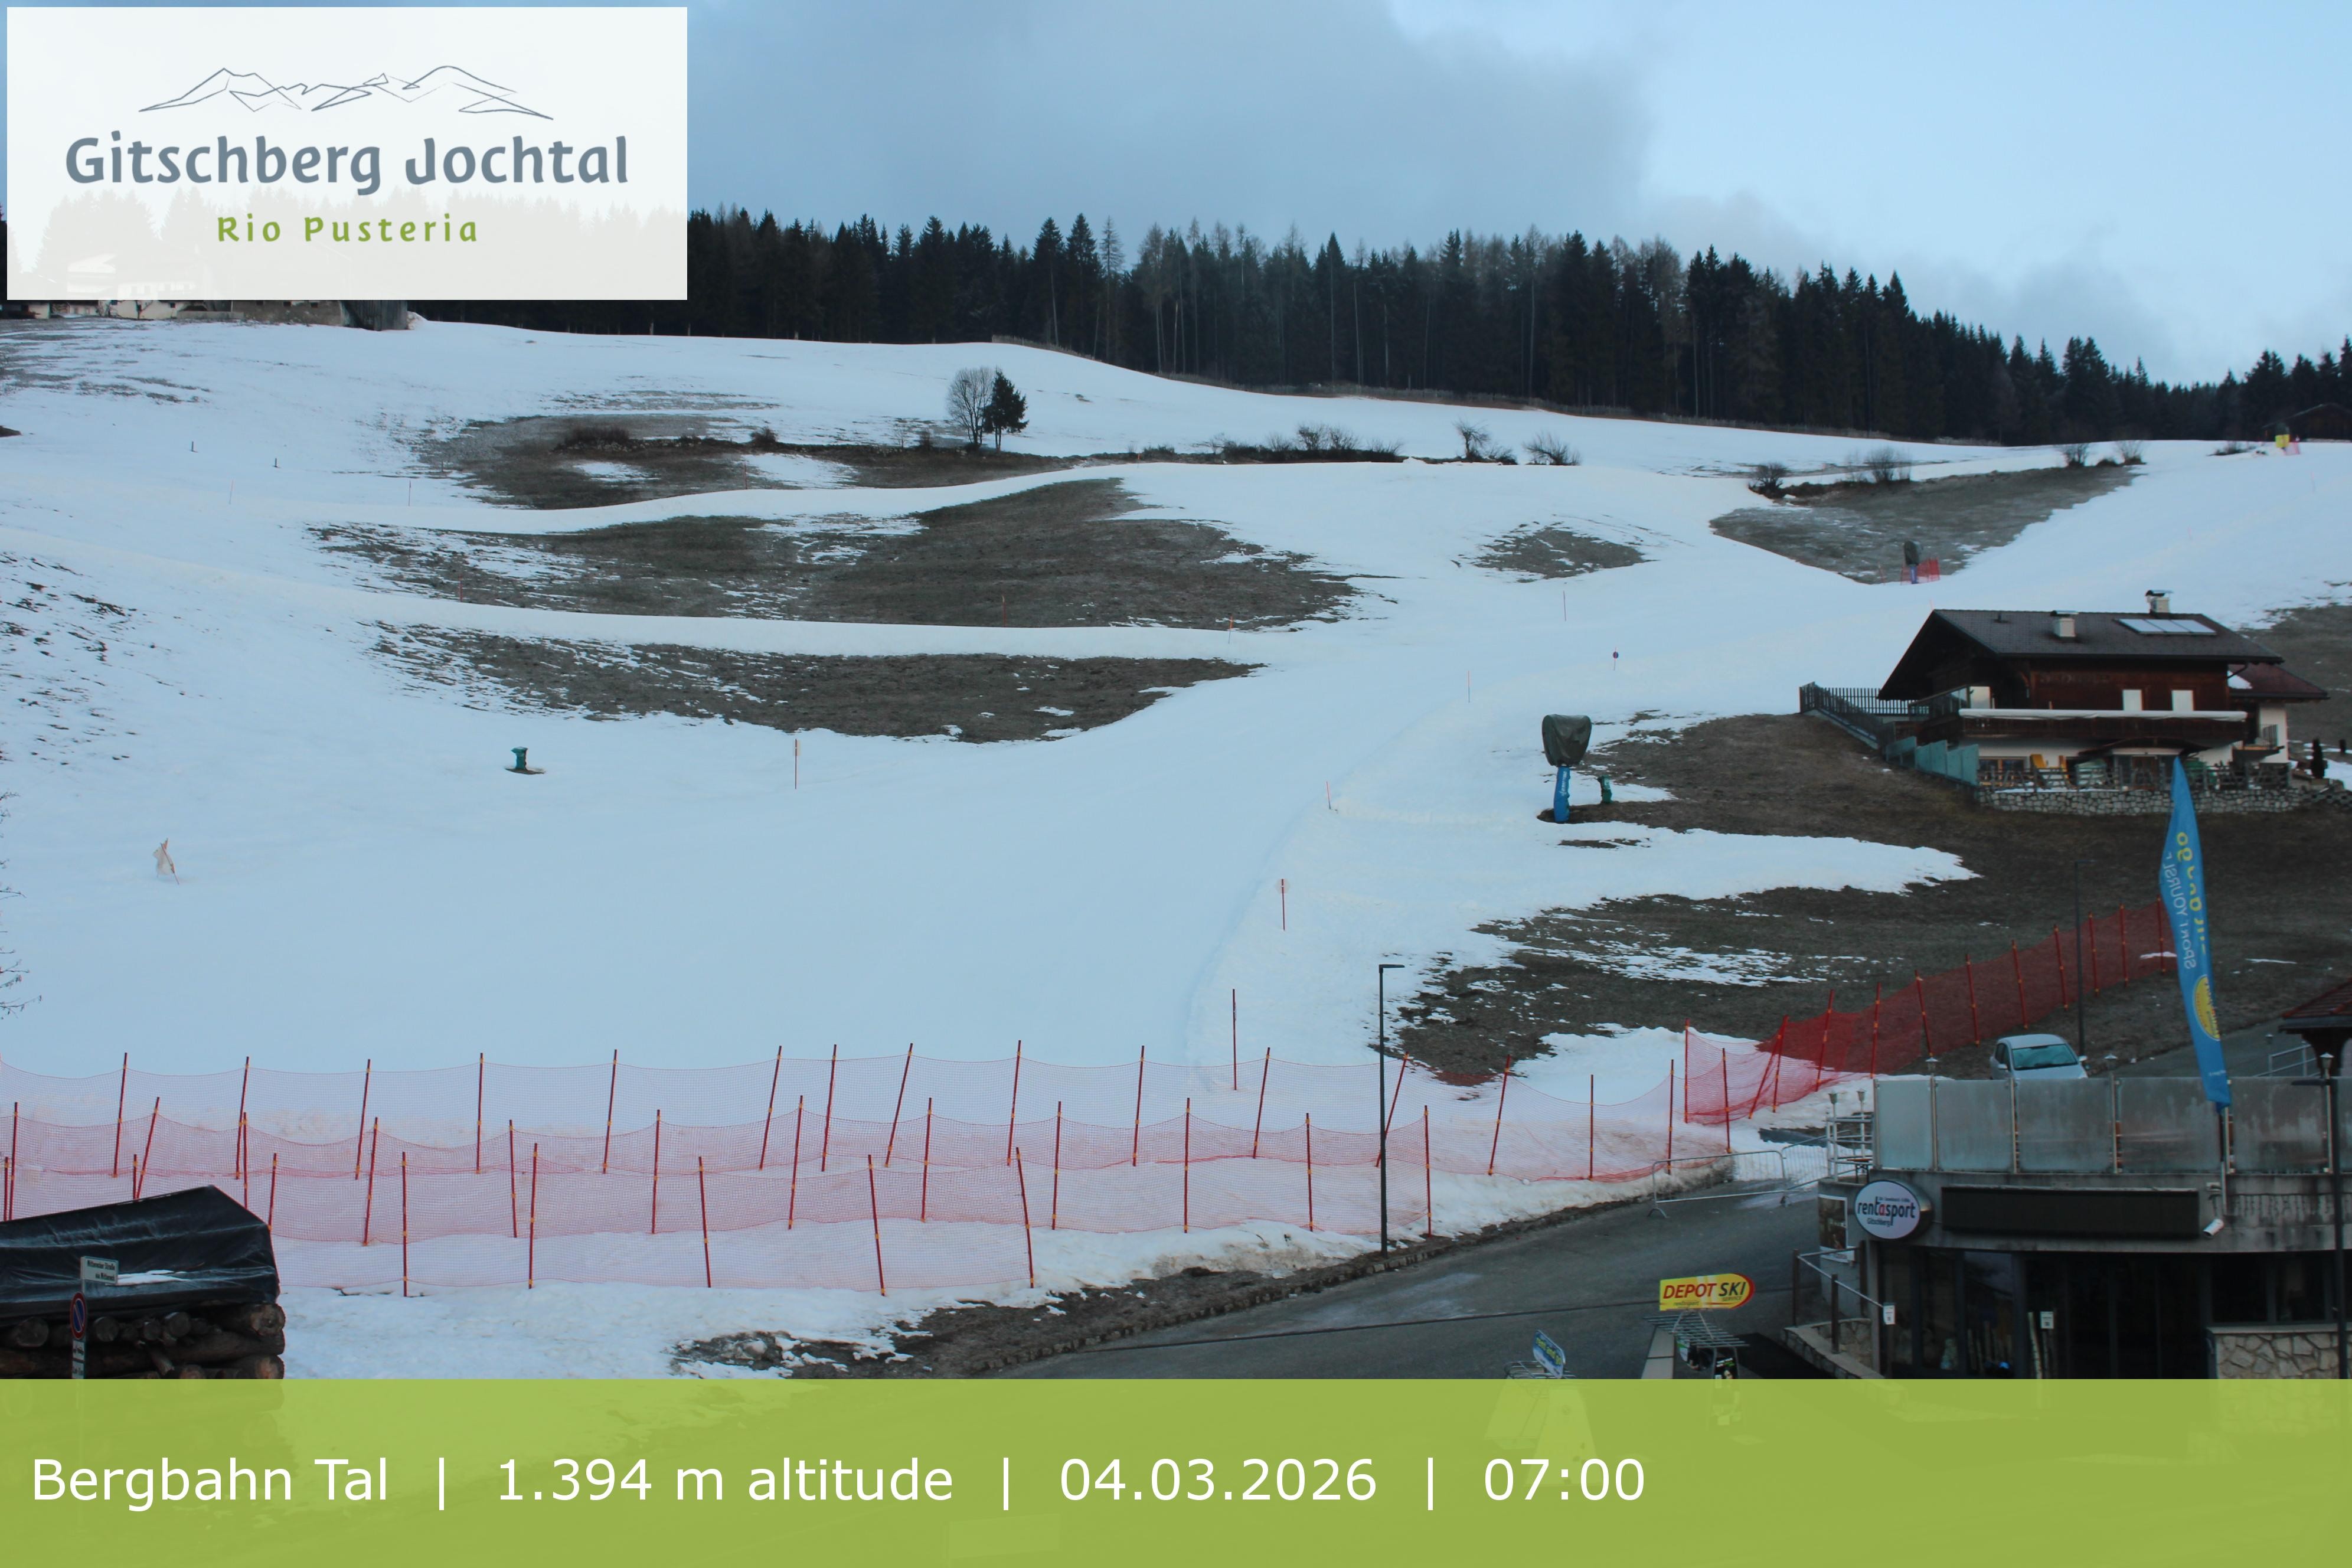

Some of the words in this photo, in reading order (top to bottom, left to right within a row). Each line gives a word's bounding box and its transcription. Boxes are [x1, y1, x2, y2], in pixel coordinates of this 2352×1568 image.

[1857, 1196, 1916, 1226] rentasport
[1662, 1283, 1717, 1299] DEPOT
[1719, 1282, 1746, 1296] SKI
